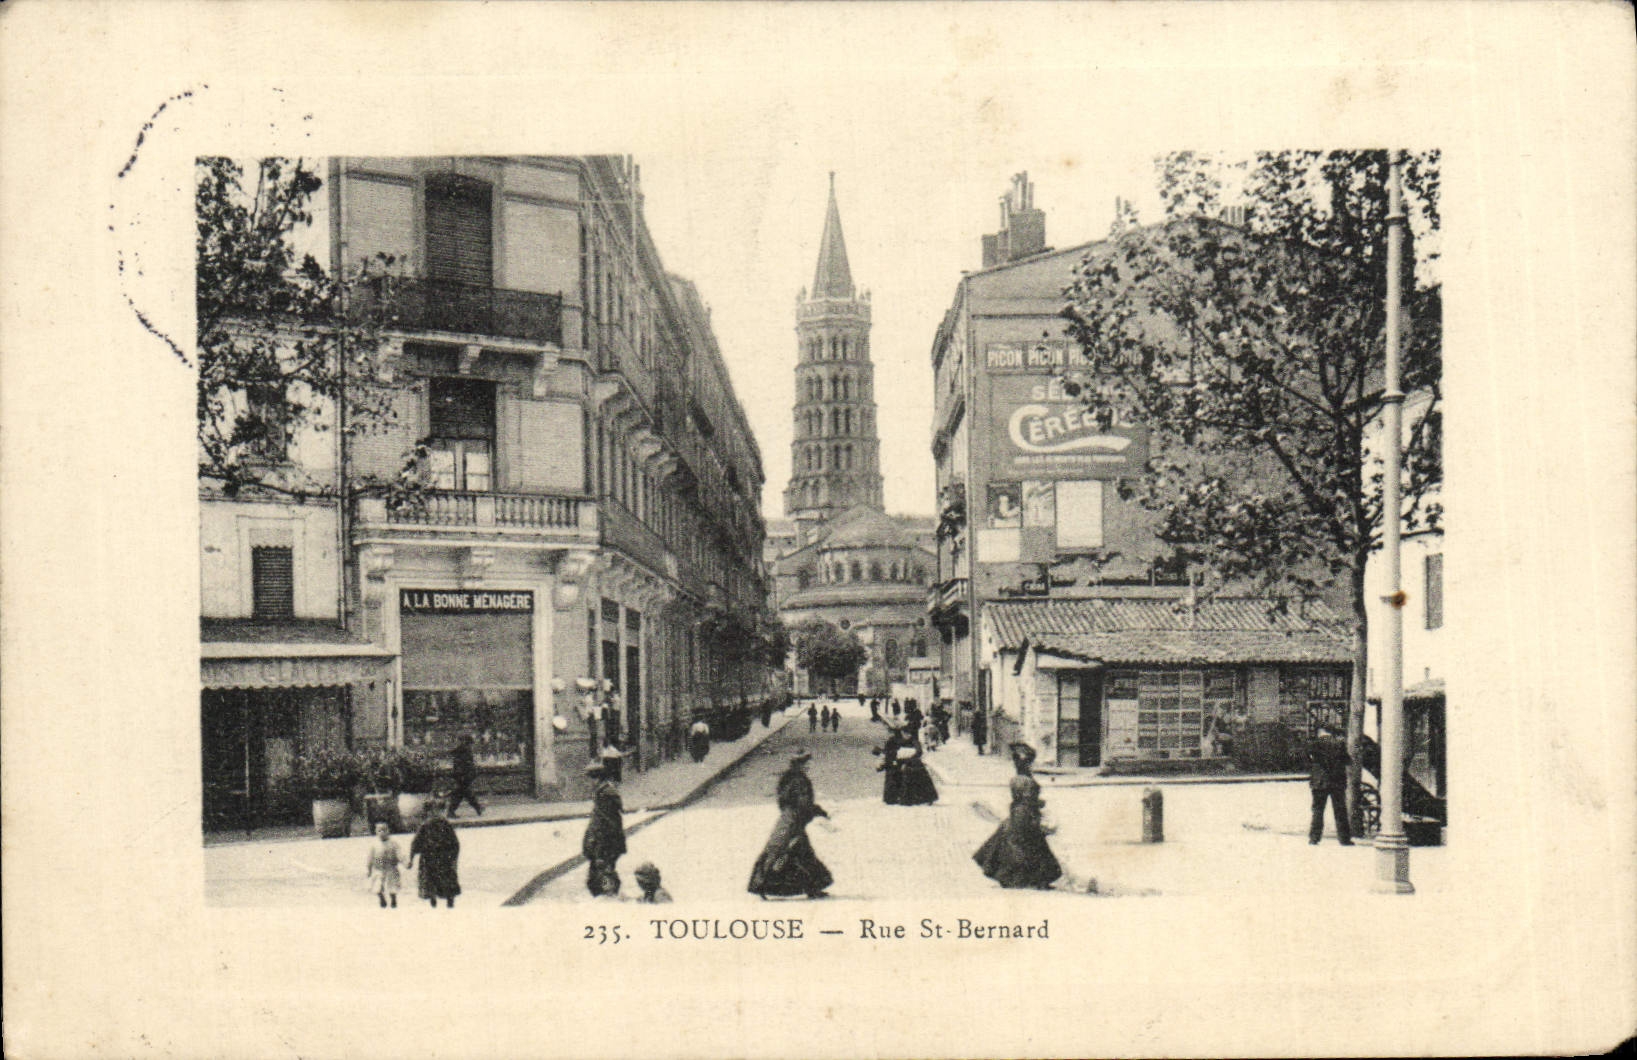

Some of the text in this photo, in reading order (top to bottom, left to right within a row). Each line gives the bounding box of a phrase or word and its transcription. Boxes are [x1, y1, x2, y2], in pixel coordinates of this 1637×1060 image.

[987, 350, 1022, 367] PICON
[414, 592, 431, 608] LA
[433, 593, 471, 609] BONNE
